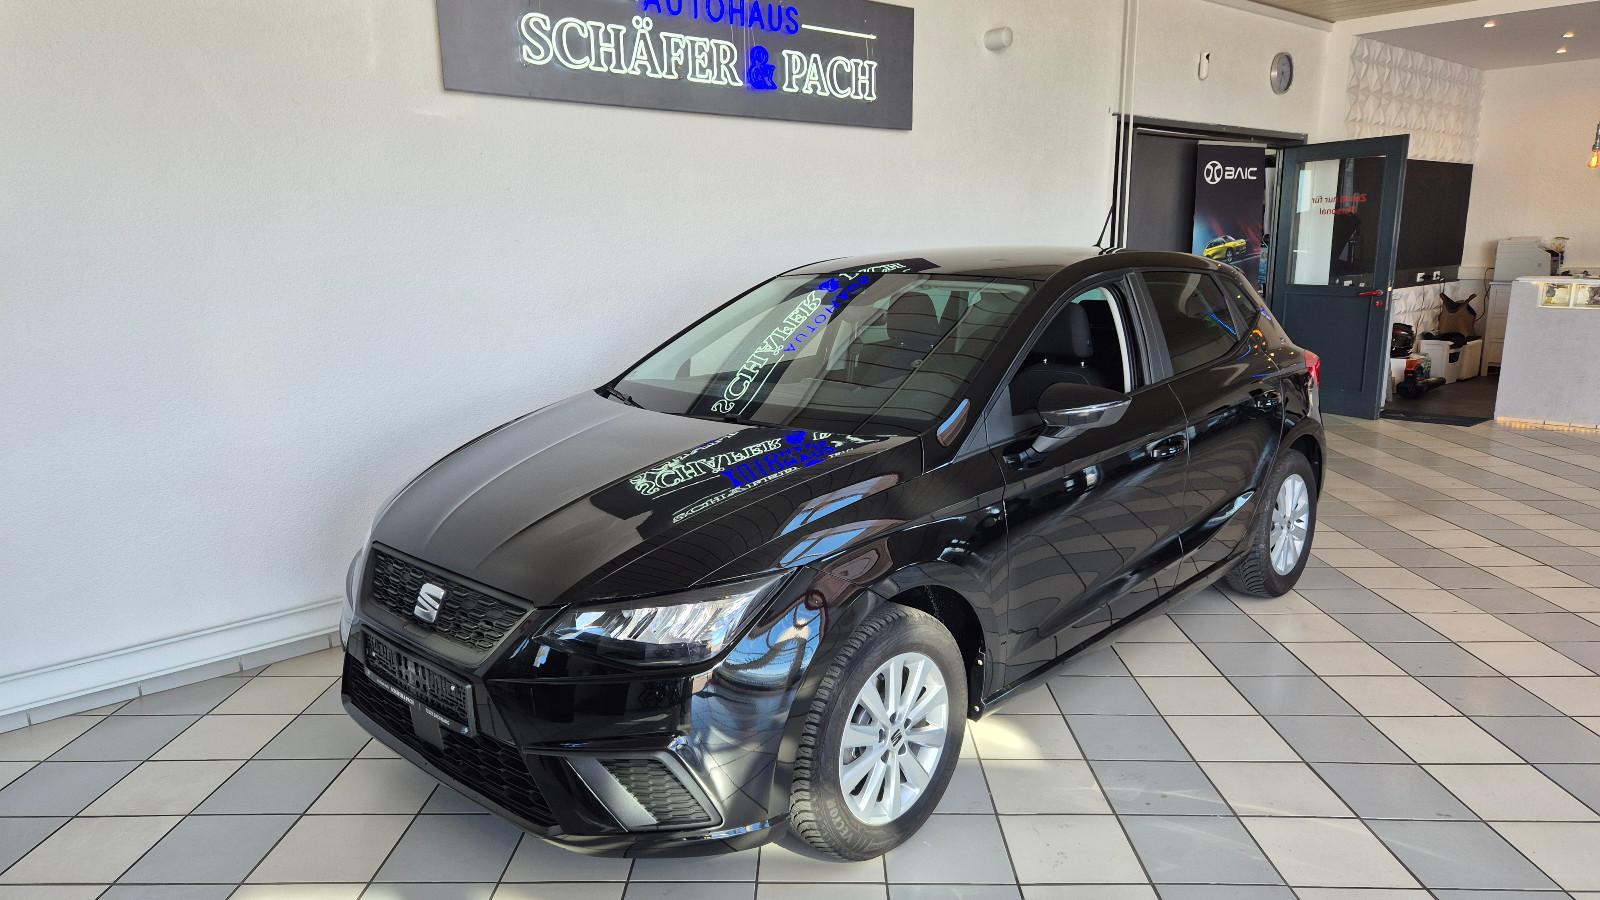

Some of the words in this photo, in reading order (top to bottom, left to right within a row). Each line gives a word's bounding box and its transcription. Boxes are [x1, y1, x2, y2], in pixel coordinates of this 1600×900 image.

[520, 12, 744, 87] SCHÄFER
[748, 45, 778, 90] &
[782, 49, 878, 101] PACH
[1224, 166, 1258, 180] BAIC
